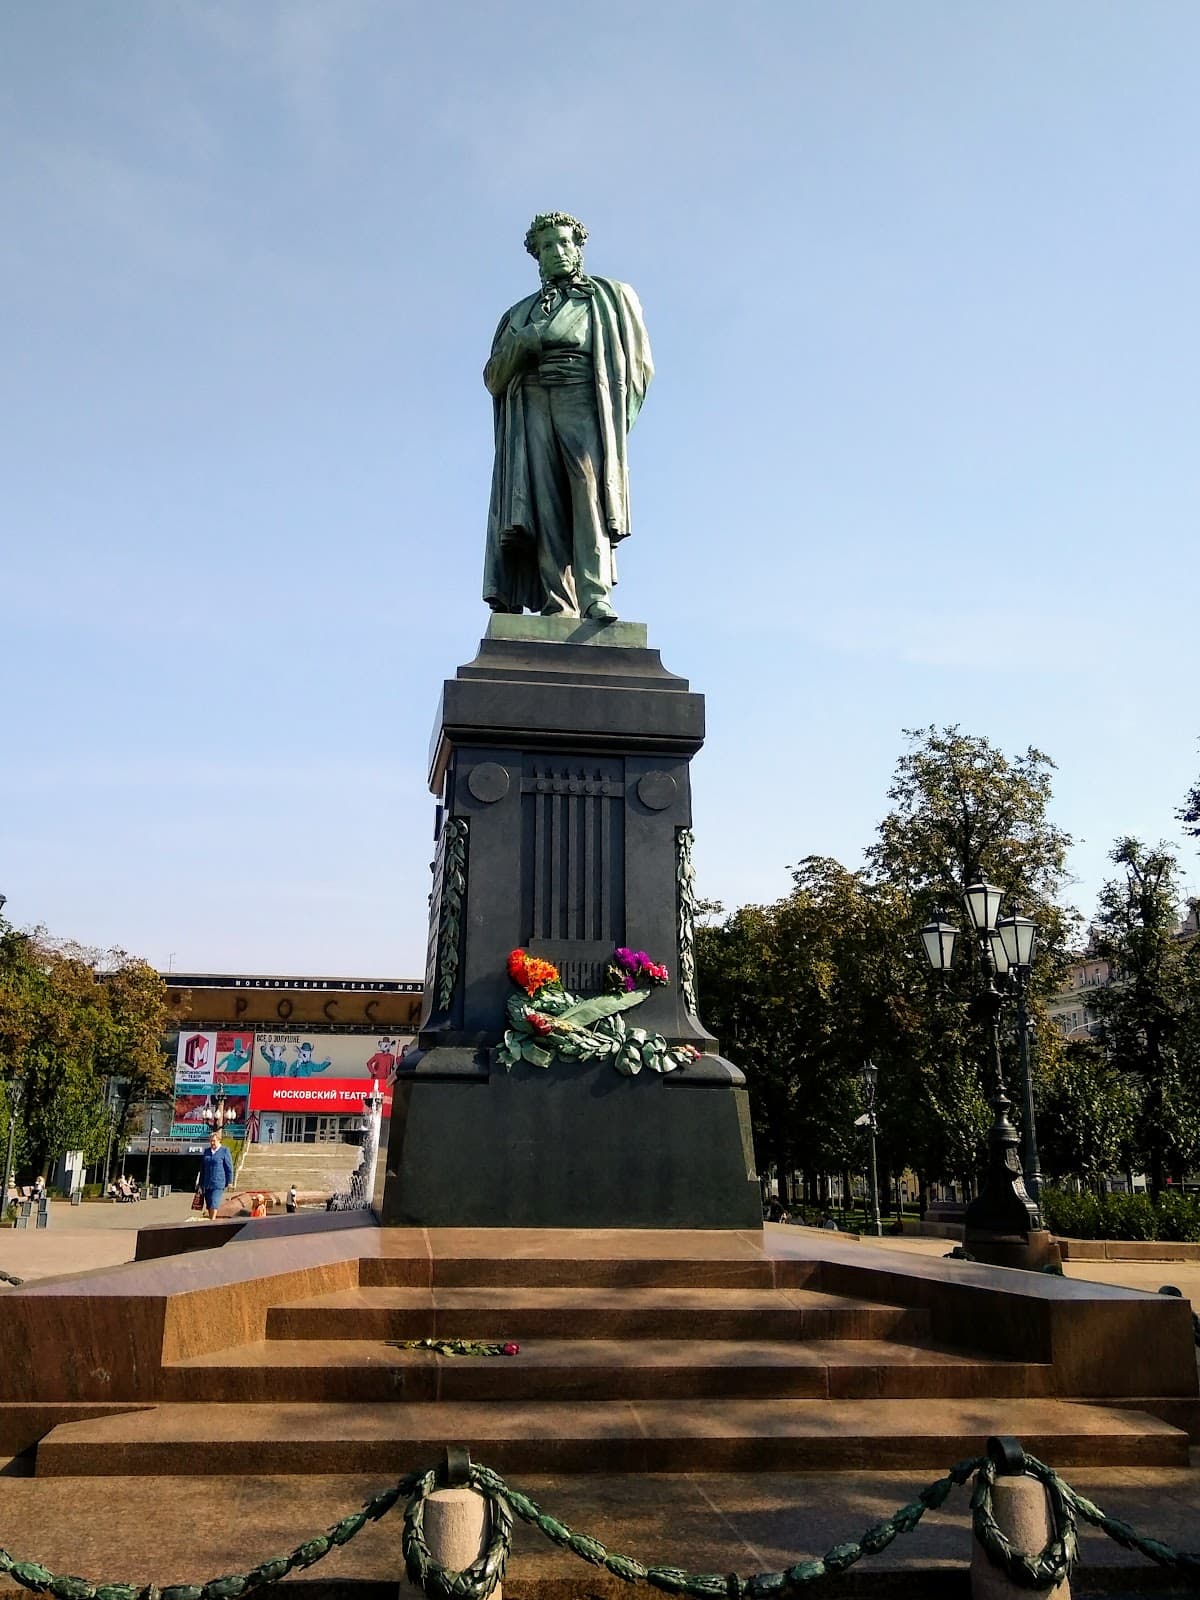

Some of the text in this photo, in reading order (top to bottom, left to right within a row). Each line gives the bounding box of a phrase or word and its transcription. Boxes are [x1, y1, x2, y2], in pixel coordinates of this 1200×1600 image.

[235, 980, 328, 988] МОСКОВСКИЙ
[235, 998, 422, 1023] РОССИ
[273, 1089, 337, 1099] МОСКОВСКИЙ
[339, 1091, 368, 1100] ТЕАТР
